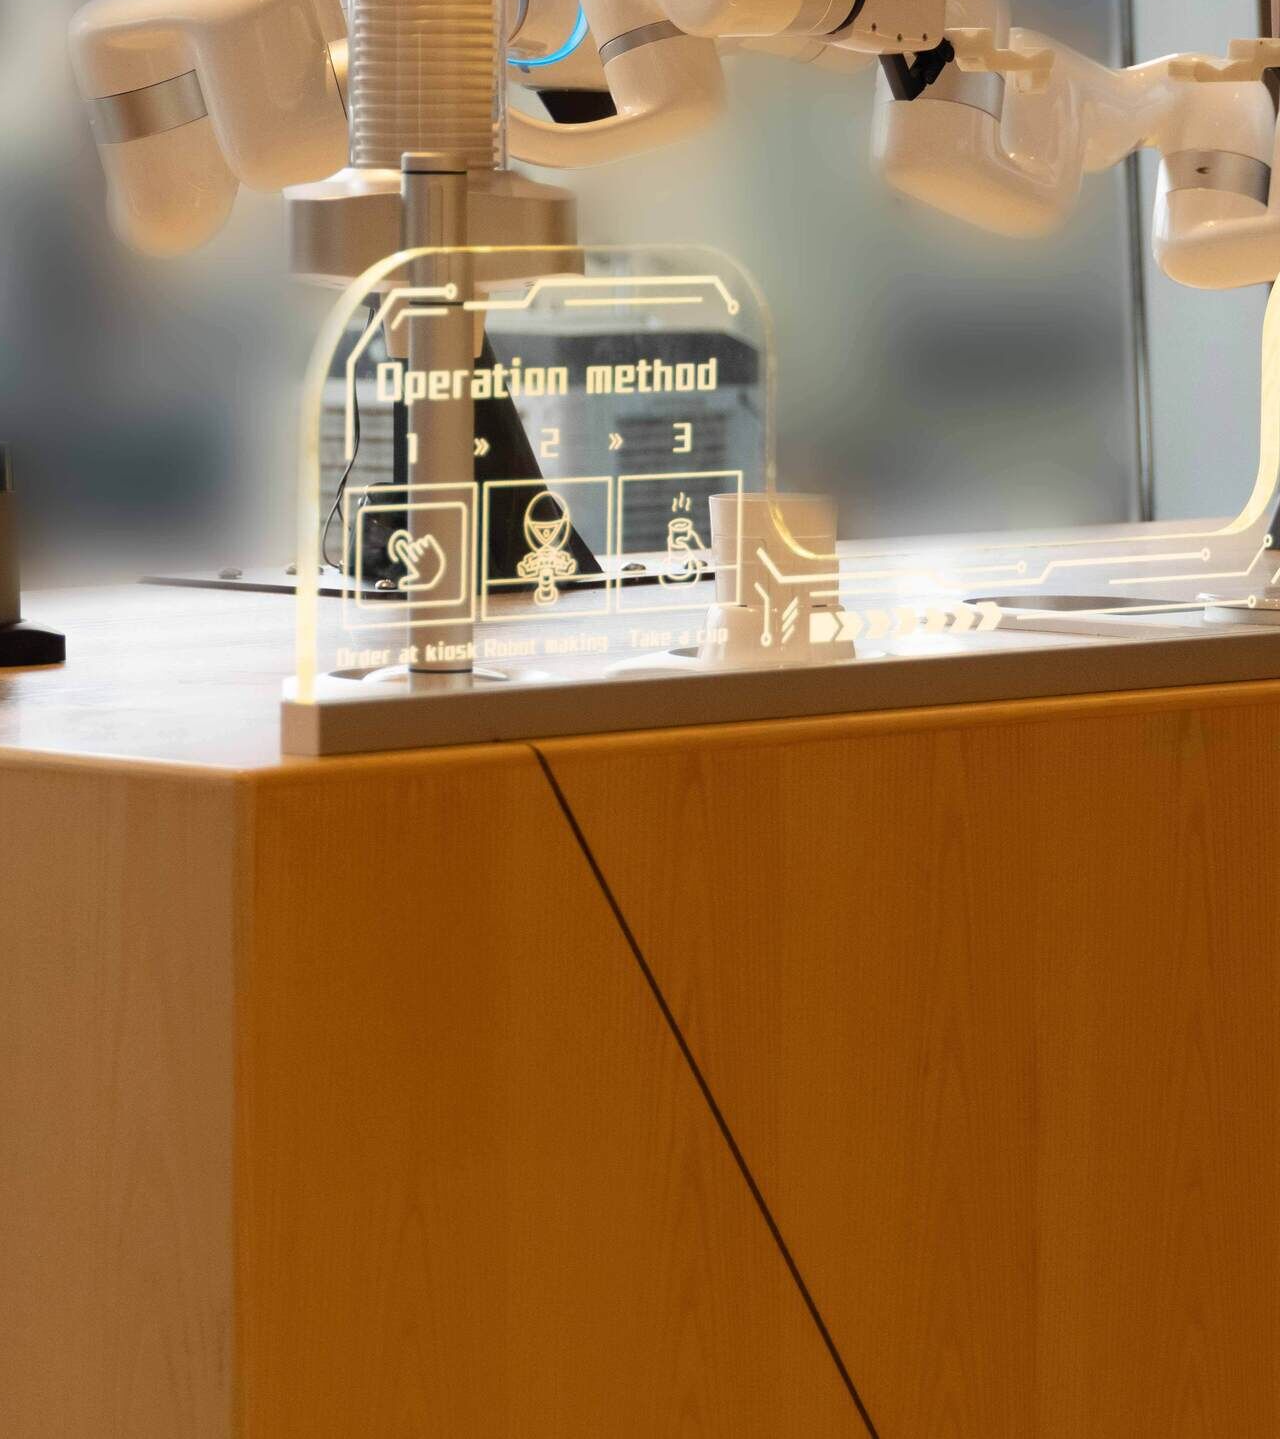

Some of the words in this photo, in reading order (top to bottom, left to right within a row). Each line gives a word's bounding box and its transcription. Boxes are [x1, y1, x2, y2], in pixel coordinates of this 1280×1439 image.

[376, 357, 568, 406] Operation
[585, 357, 718, 394] method
[406, 432, 419, 465] 1
[539, 427, 561, 459] 2
[672, 422, 693, 453] 3
[336, 647, 390, 669] Order
[399, 645, 419, 663] at
[425, 640, 478, 663] kiosk
[483, 638, 536, 658] Robot
